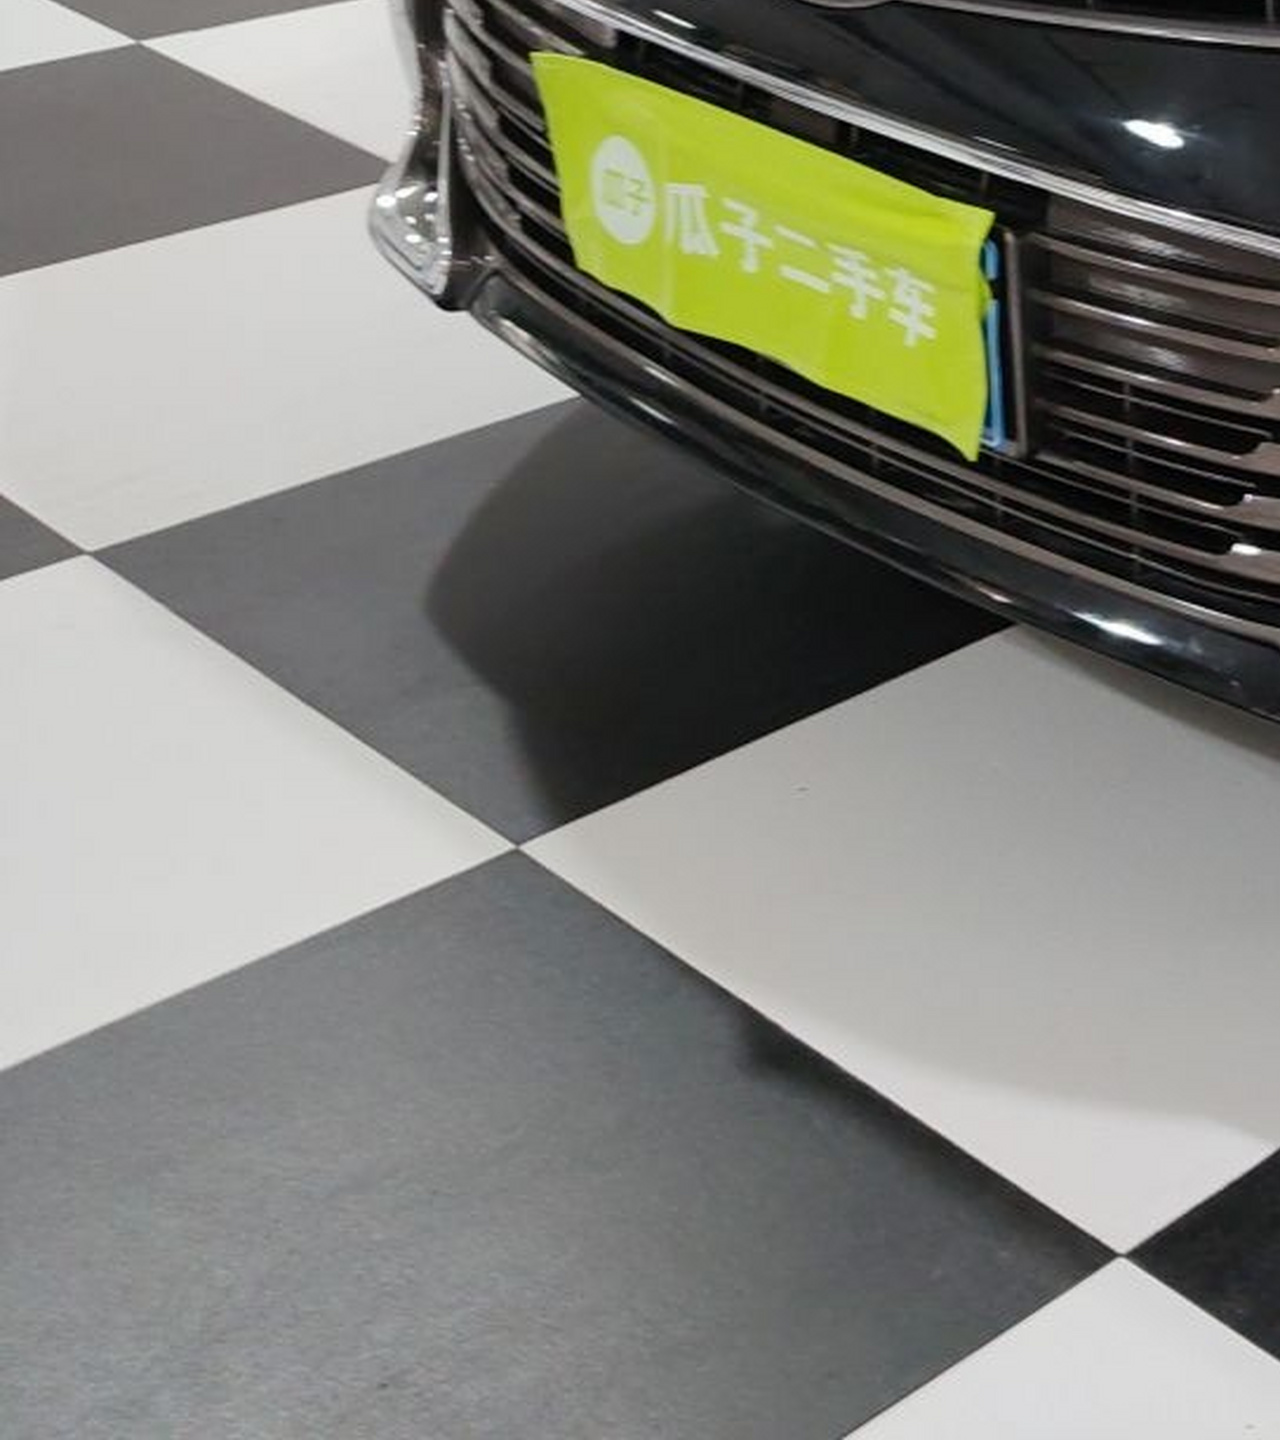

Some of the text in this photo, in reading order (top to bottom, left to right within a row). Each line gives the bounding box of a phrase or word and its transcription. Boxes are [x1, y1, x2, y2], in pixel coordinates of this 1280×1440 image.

[664, 183, 937, 347] 瓜子二手车
